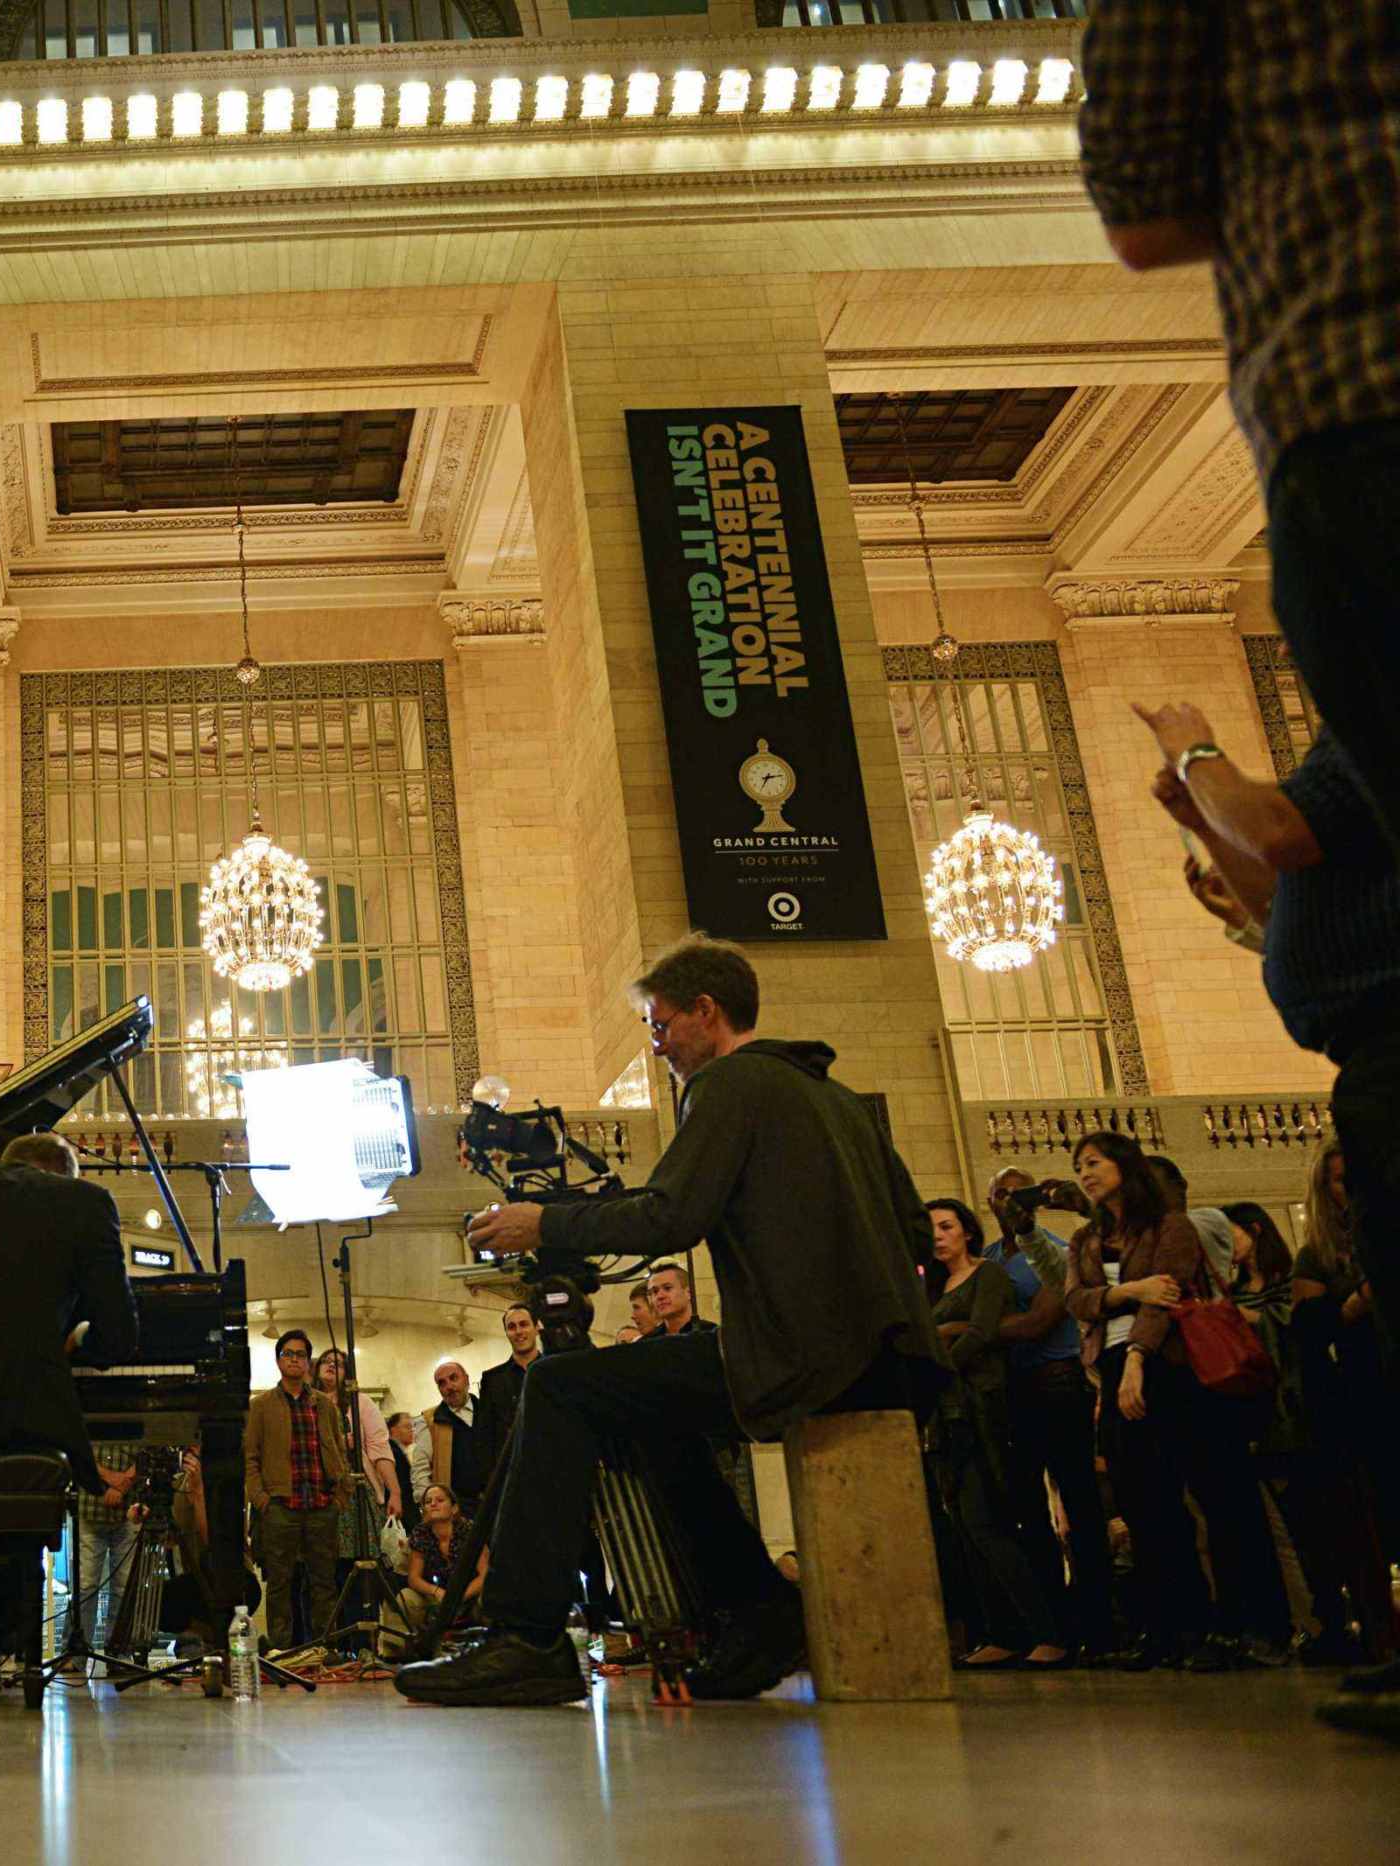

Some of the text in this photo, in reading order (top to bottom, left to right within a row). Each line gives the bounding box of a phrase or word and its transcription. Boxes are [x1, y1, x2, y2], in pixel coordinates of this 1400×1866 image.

[666, 425, 737, 718] ISN'T IT GRAND
[702, 423, 772, 685] CELEBRATION
[736, 421, 809, 697] A CENTENNIAL
[712, 836, 839, 847] GRAND CENTRAL
[739, 855, 818, 866] 100 YEARS
